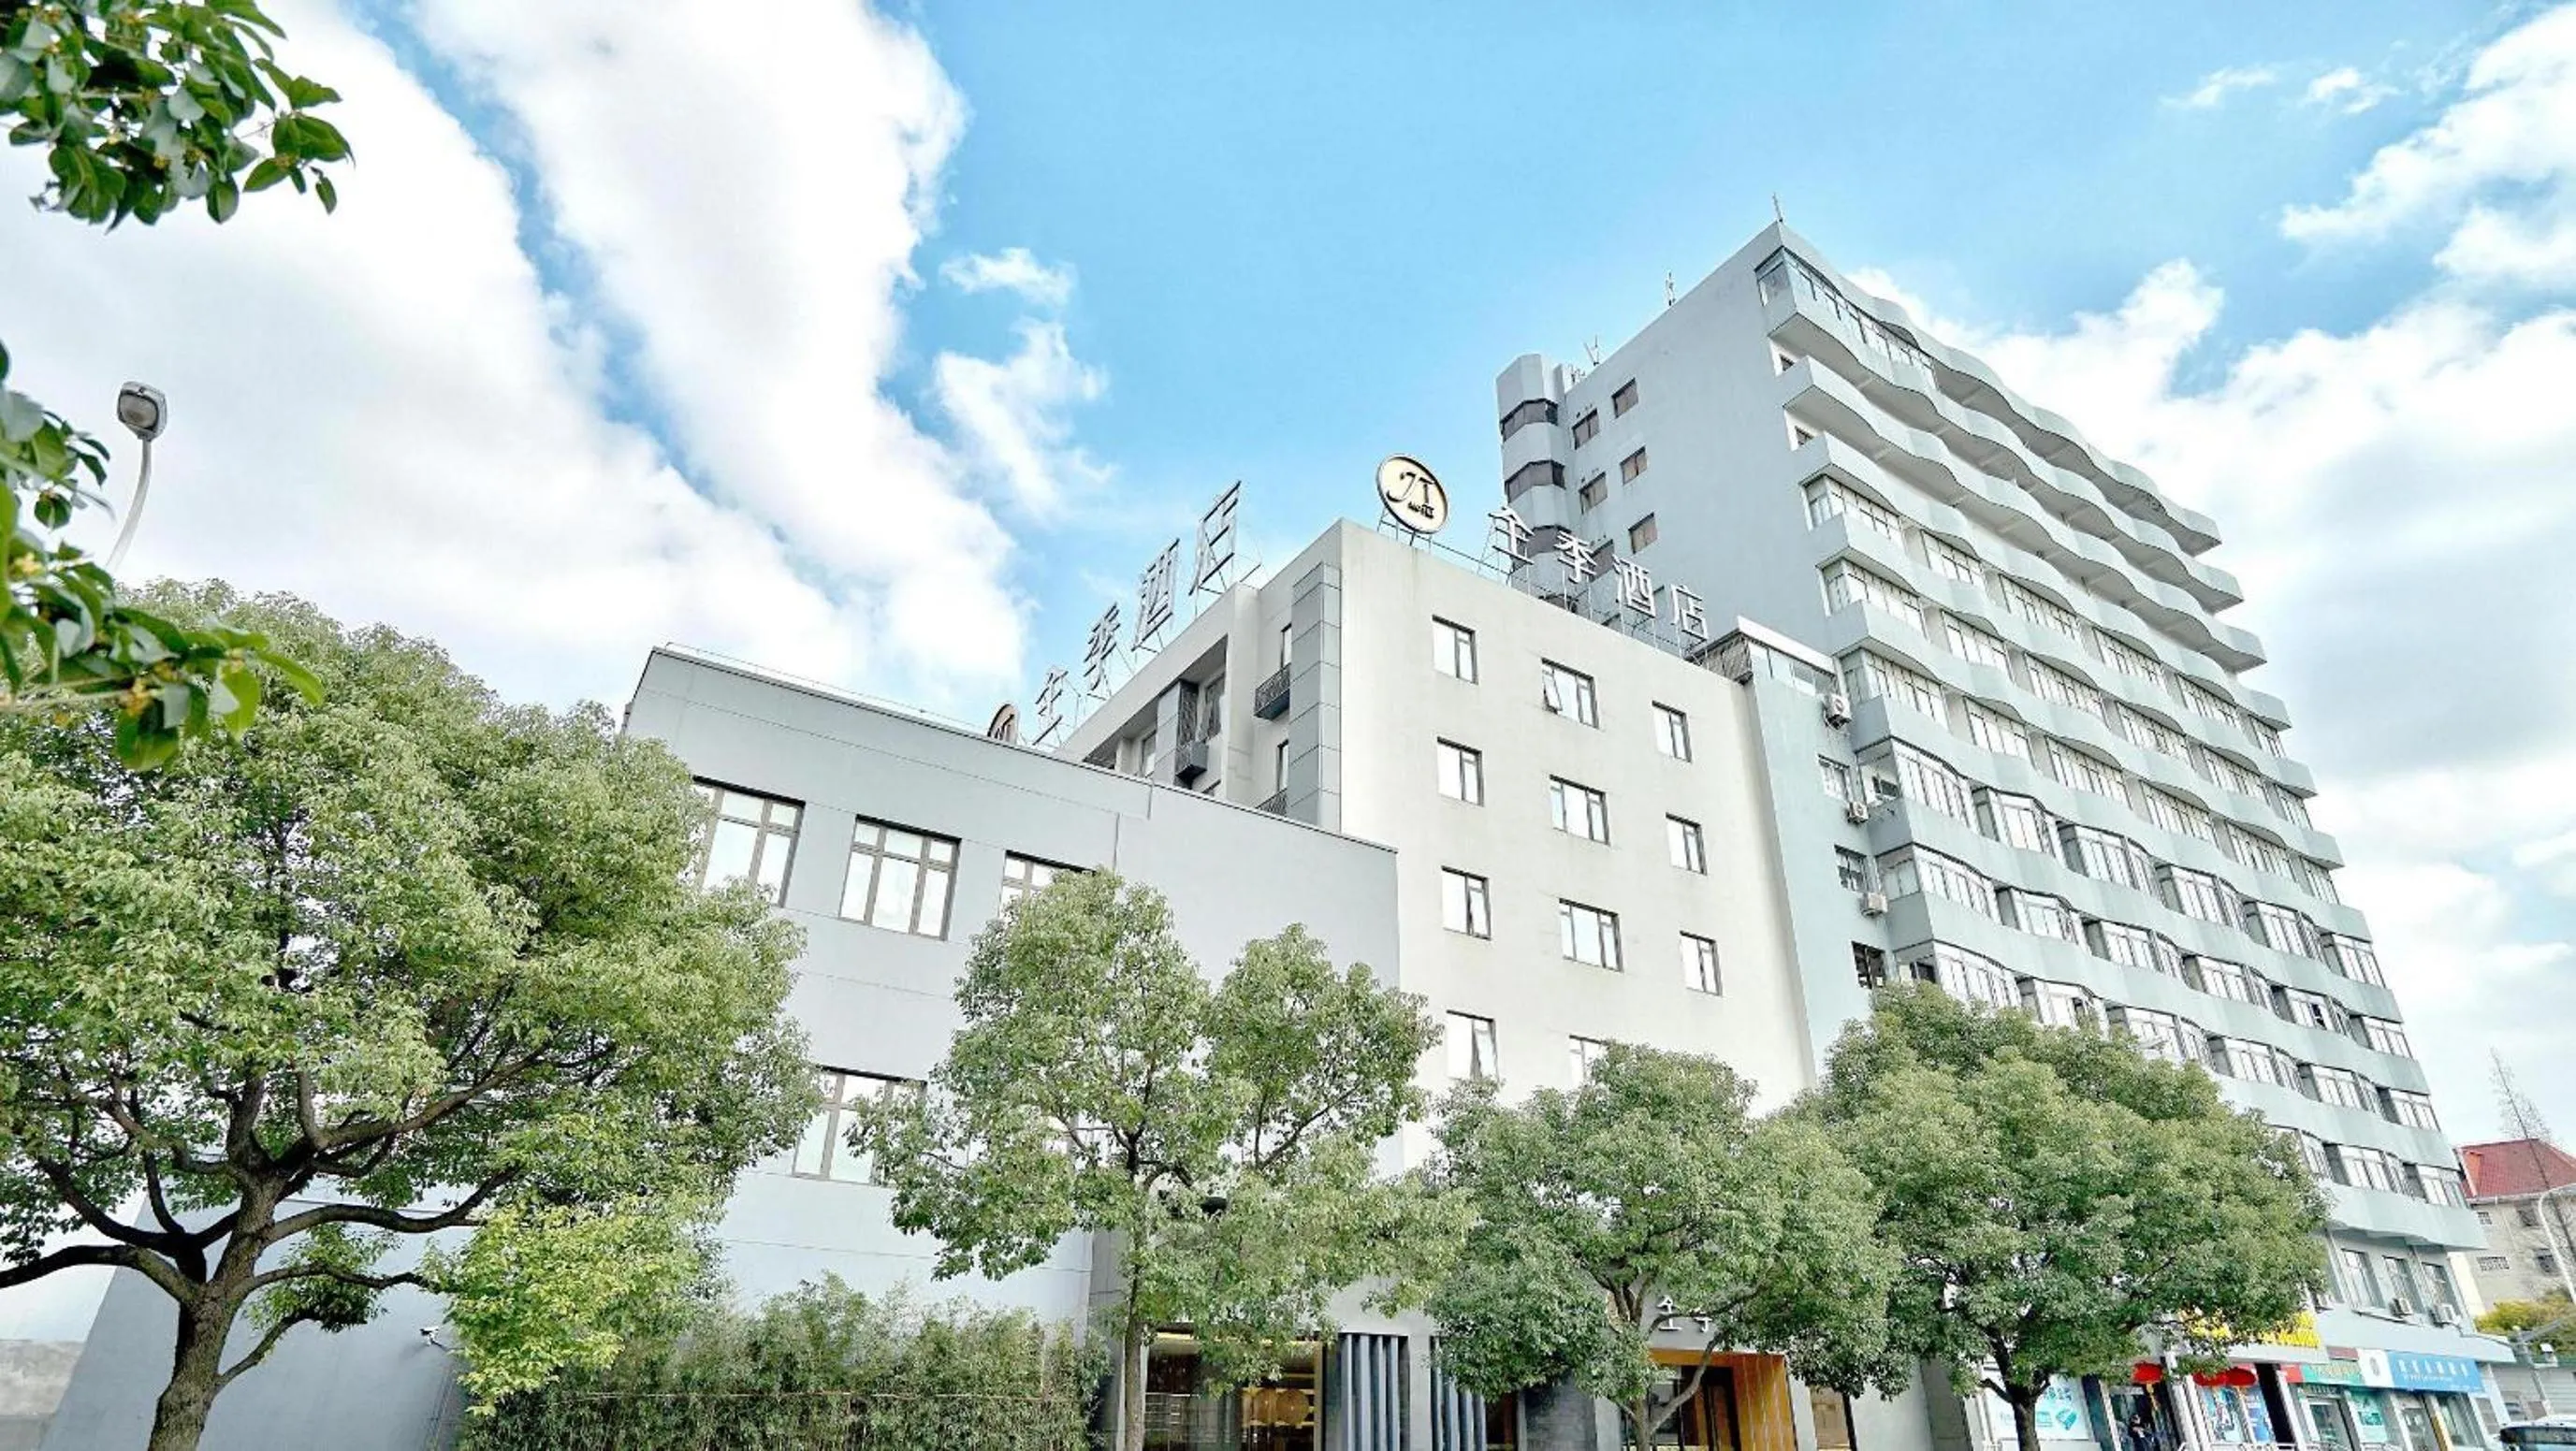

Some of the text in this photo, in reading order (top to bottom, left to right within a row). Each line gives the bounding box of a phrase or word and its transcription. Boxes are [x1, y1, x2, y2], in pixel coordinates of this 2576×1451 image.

[1033, 480, 1242, 747] 全季酒店
[1488, 505, 1709, 641] 全季酒店
